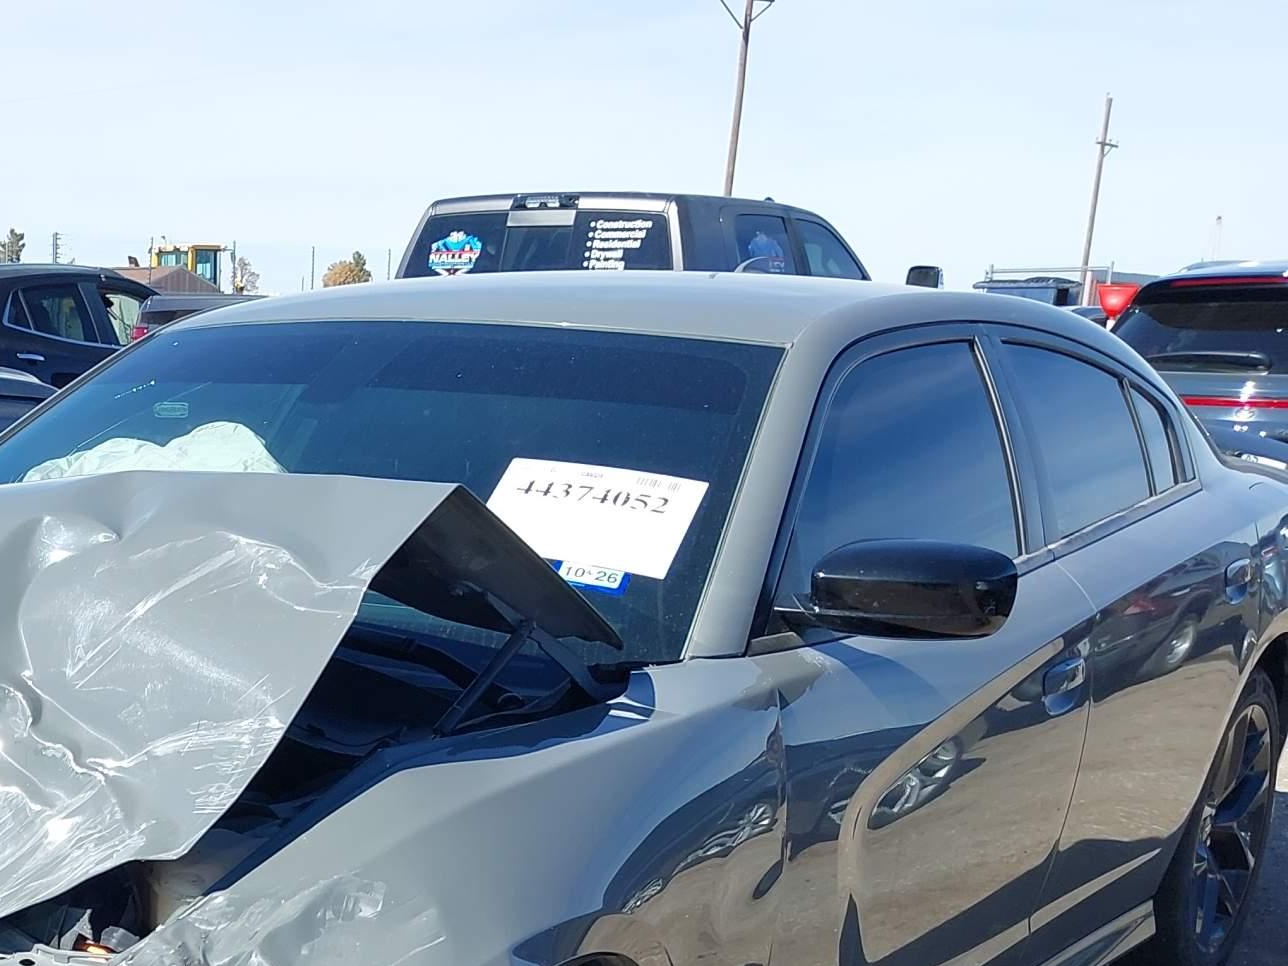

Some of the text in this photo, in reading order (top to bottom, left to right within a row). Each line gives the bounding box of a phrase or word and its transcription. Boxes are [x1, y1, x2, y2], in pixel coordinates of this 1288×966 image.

[595, 229, 647, 239] Commercial
[592, 239, 642, 249] Residential
[429, 252, 480, 263] NALLEY
[516, 479, 670, 515] 44374052
